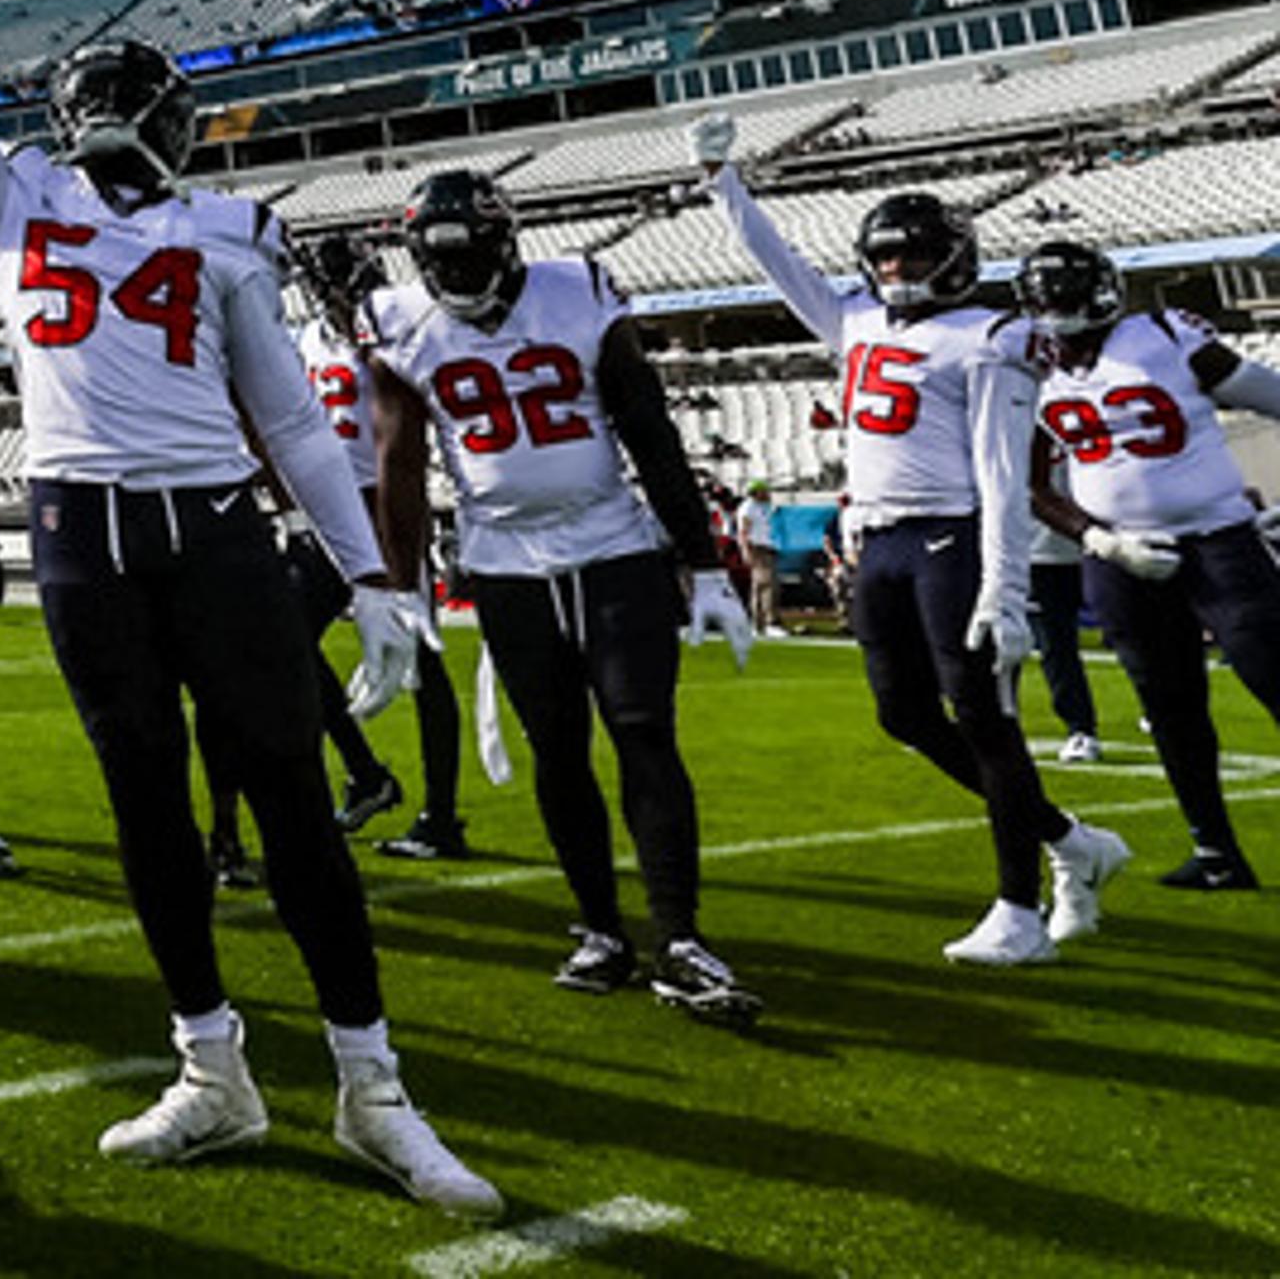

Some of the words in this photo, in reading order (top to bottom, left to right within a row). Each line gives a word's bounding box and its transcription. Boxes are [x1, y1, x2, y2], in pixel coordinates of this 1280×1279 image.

[19, 220, 204, 368] 54
[432, 344, 594, 454] 92
[843, 342, 928, 435] 15
[1042, 385, 1188, 463] 93
